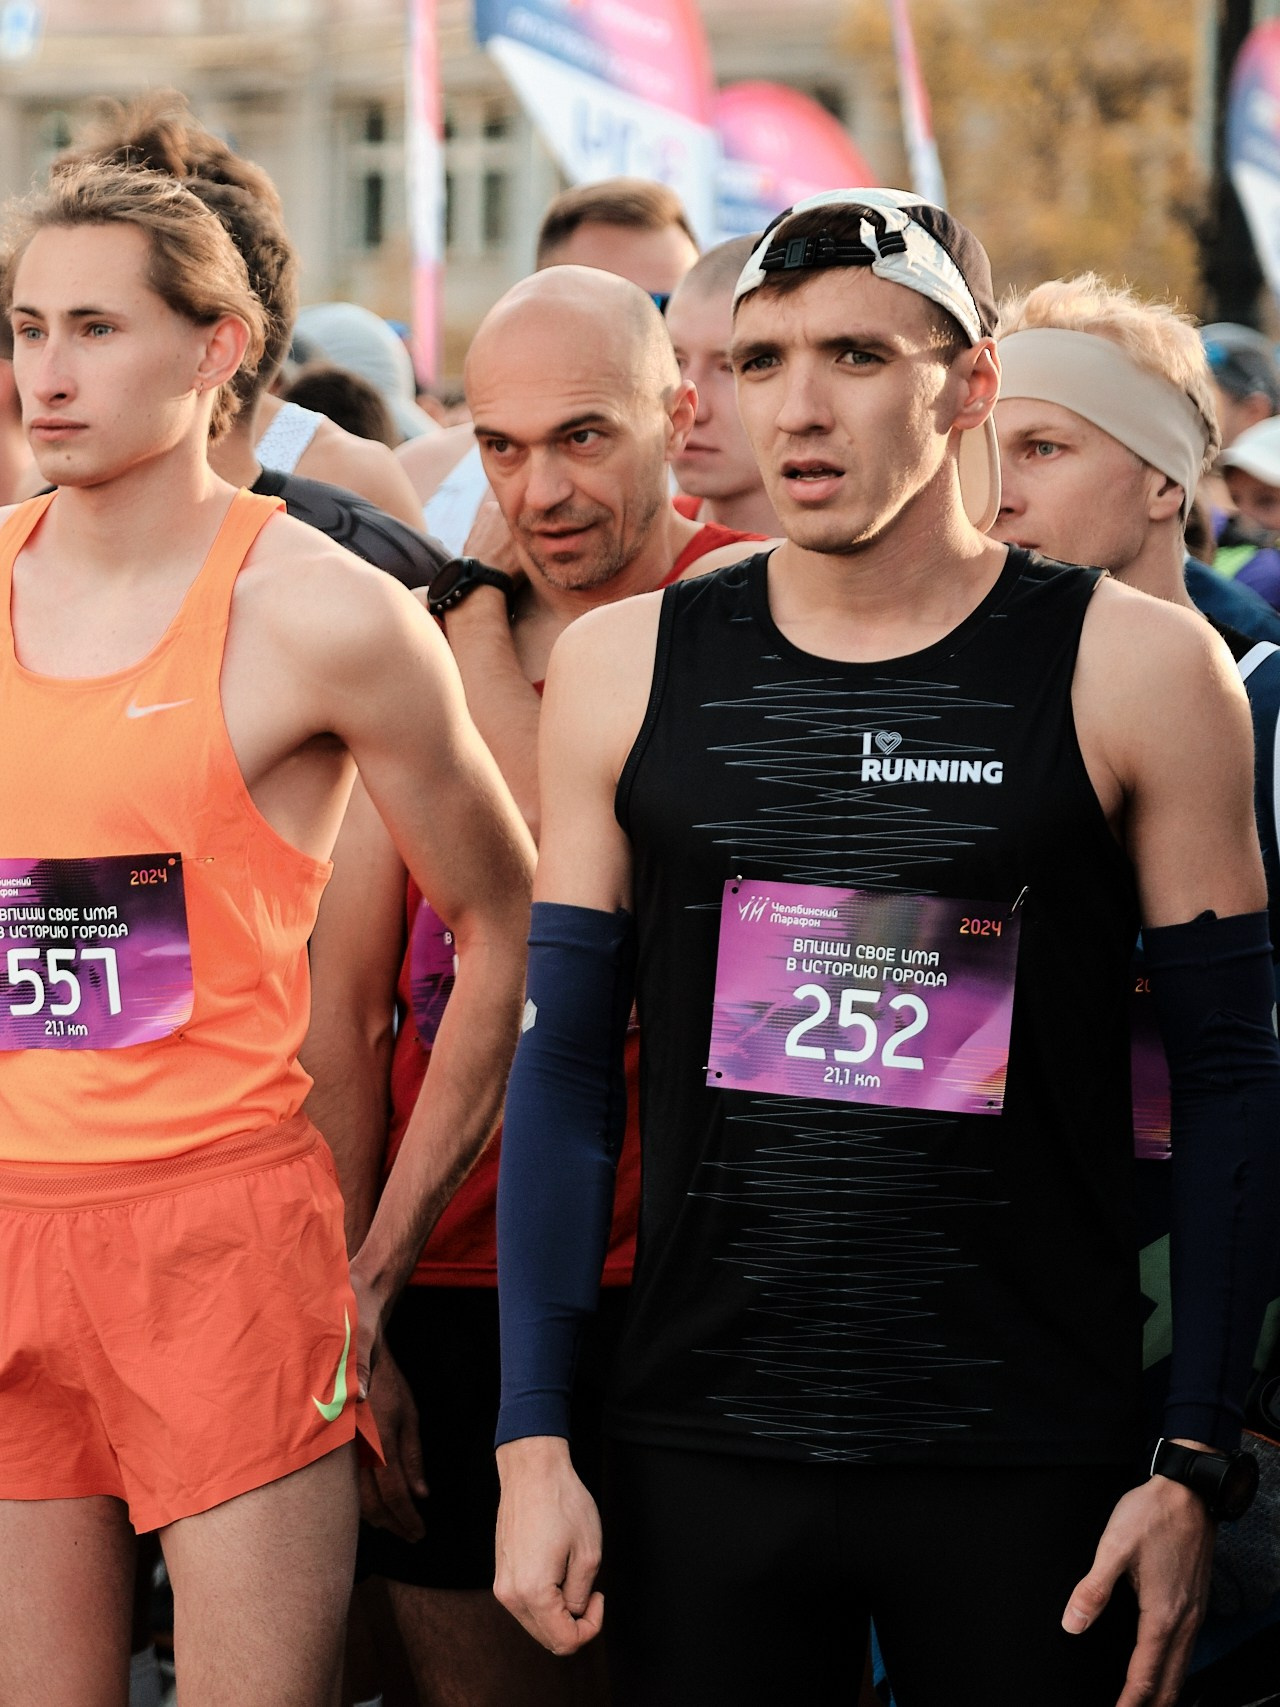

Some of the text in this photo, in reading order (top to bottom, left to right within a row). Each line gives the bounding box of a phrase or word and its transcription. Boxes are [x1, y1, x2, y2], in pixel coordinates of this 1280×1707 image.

[862, 732, 872, 755] I
[861, 758, 1004, 784] RUNNING
[130, 868, 167, 885] 2024
[48, 907, 79, 920] СВОЕ
[83, 906, 118, 920] ИМЯ
[771, 902, 838, 918] Челябинский
[770, 913, 820, 928] Марафон
[960, 918, 1002, 936] 2024
[9, 924, 68, 939] ИСТОРИЮ
[71, 923, 128, 939] ГОРОДА
[793, 938, 939, 966] ВПИШИ СВОЕ ИМЯ
[786, 956, 947, 987] В ИСТОРИЮ ГОРОДА
[7, 947, 122, 1016] 557
[44, 1020, 64, 1037] 21,1
[785, 983, 929, 1070] 252
[823, 1067, 850, 1085] 21,1
